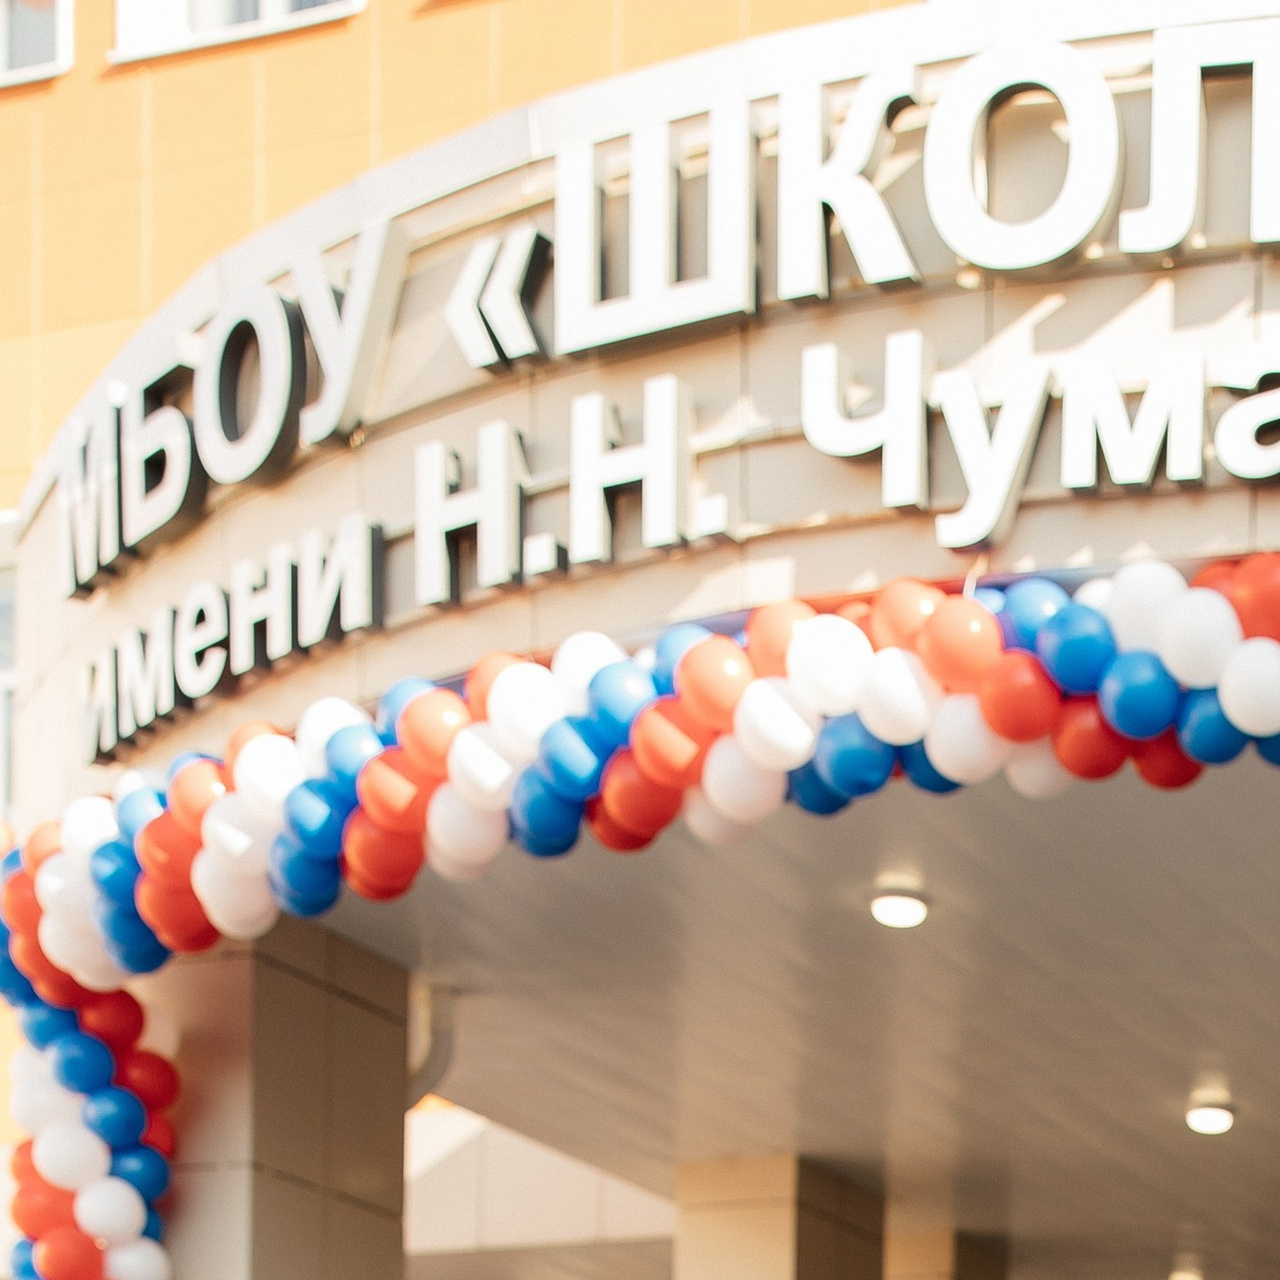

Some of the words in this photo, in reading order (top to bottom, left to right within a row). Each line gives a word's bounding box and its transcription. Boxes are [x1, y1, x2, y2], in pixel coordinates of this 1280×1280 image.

[56, 217, 395, 600] МБОУ
[84, 512, 384, 766] имени
[414, 373, 730, 606] Н.Н.
